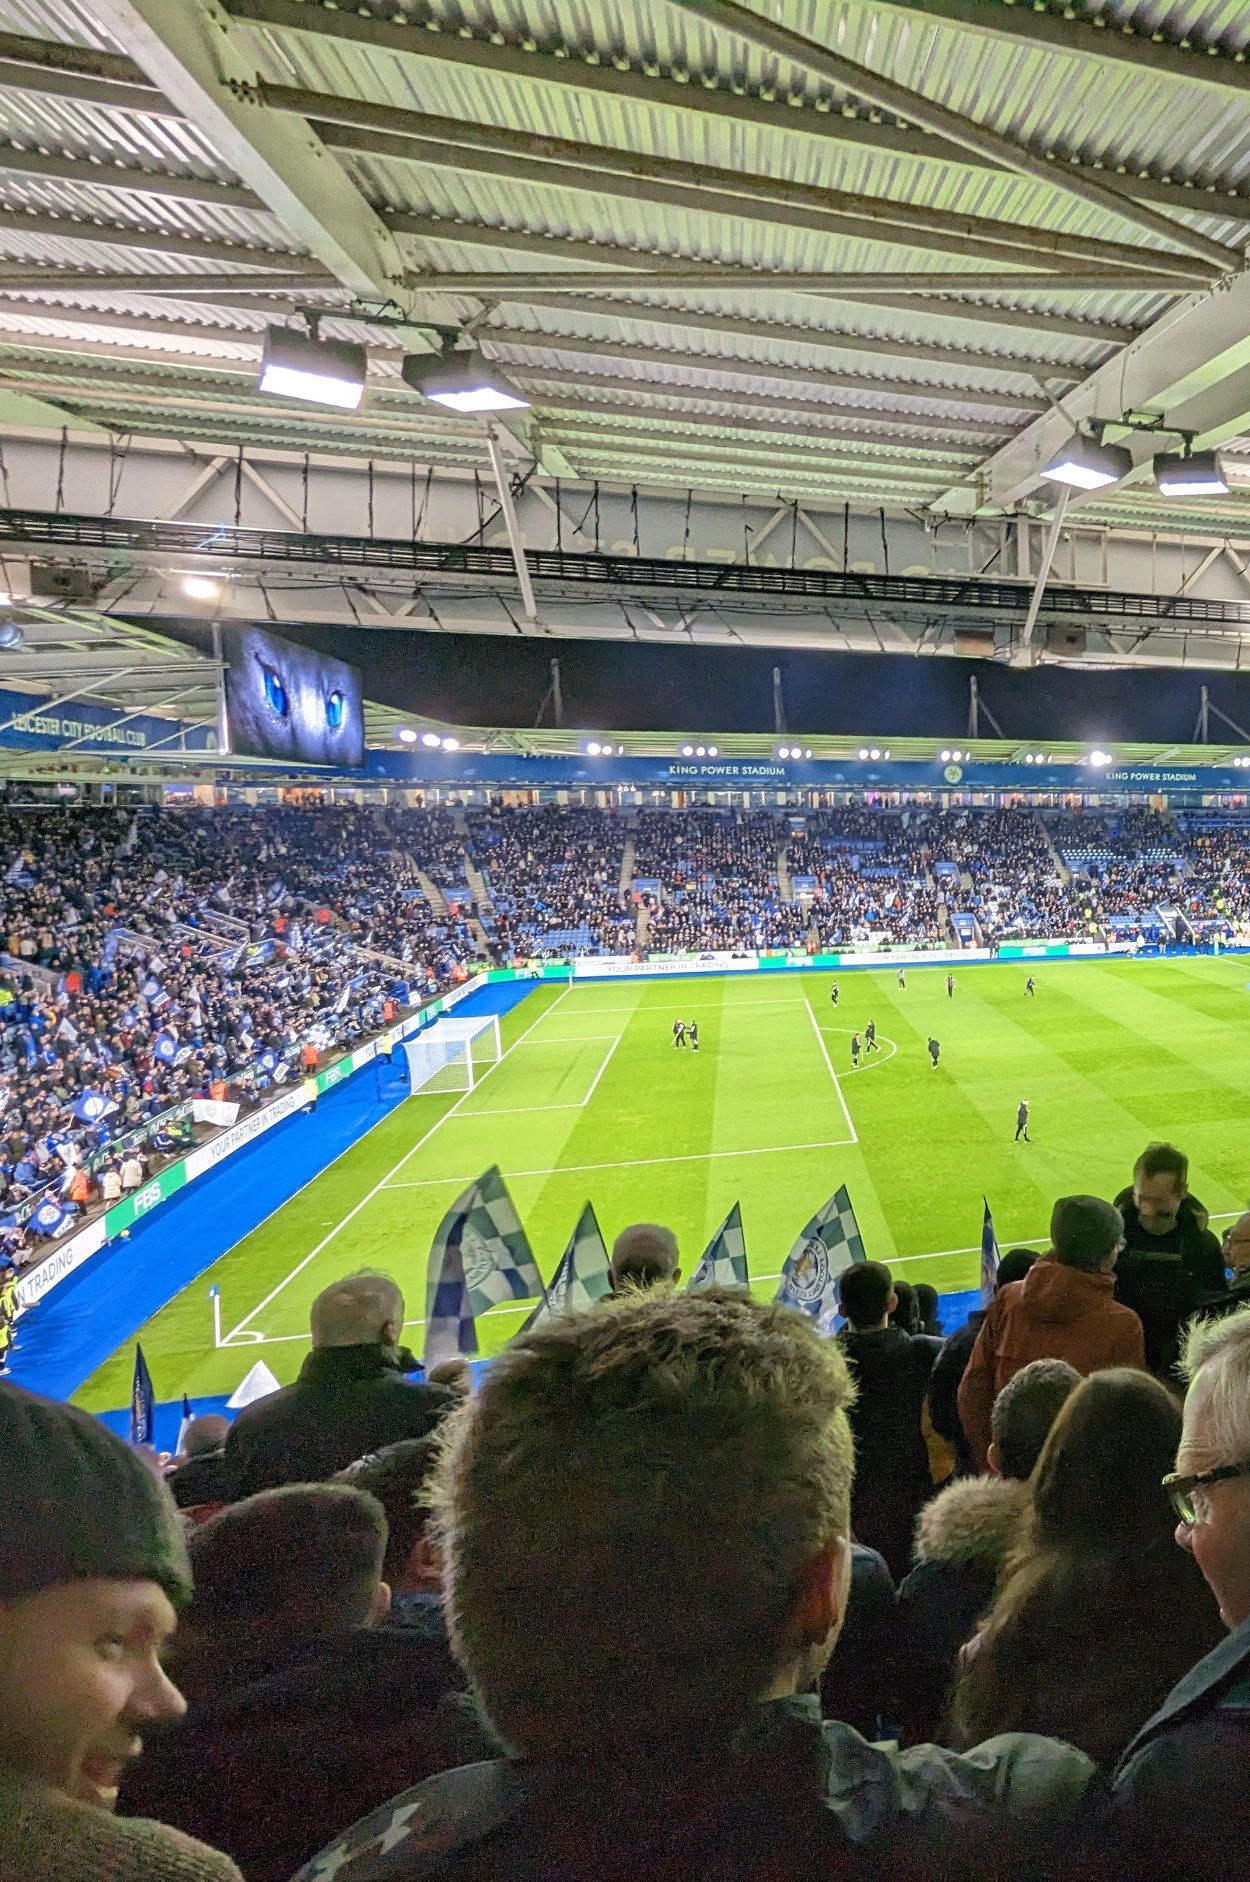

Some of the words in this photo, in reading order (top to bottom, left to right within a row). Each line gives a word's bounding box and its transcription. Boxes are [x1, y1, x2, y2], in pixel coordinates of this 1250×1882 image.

[62, 720, 82, 738] CITY
[669, 766, 698, 775] KING
[701, 766, 739, 775] POWER
[742, 766, 785, 776] STADIUM
[1106, 772, 1129, 780] KING
[1162, 773, 1197, 781] STADIUM
[691, 961, 729, 969] TRADING
[210, 1136, 232, 1159] YOUR
[231, 1117, 261, 1146] PARTNER
[261, 1113, 269, 1127] IN
[269, 1096, 295, 1121] TRADING
[133, 1181, 161, 1216] FBS
[27, 1248, 74, 1297] TRADING
